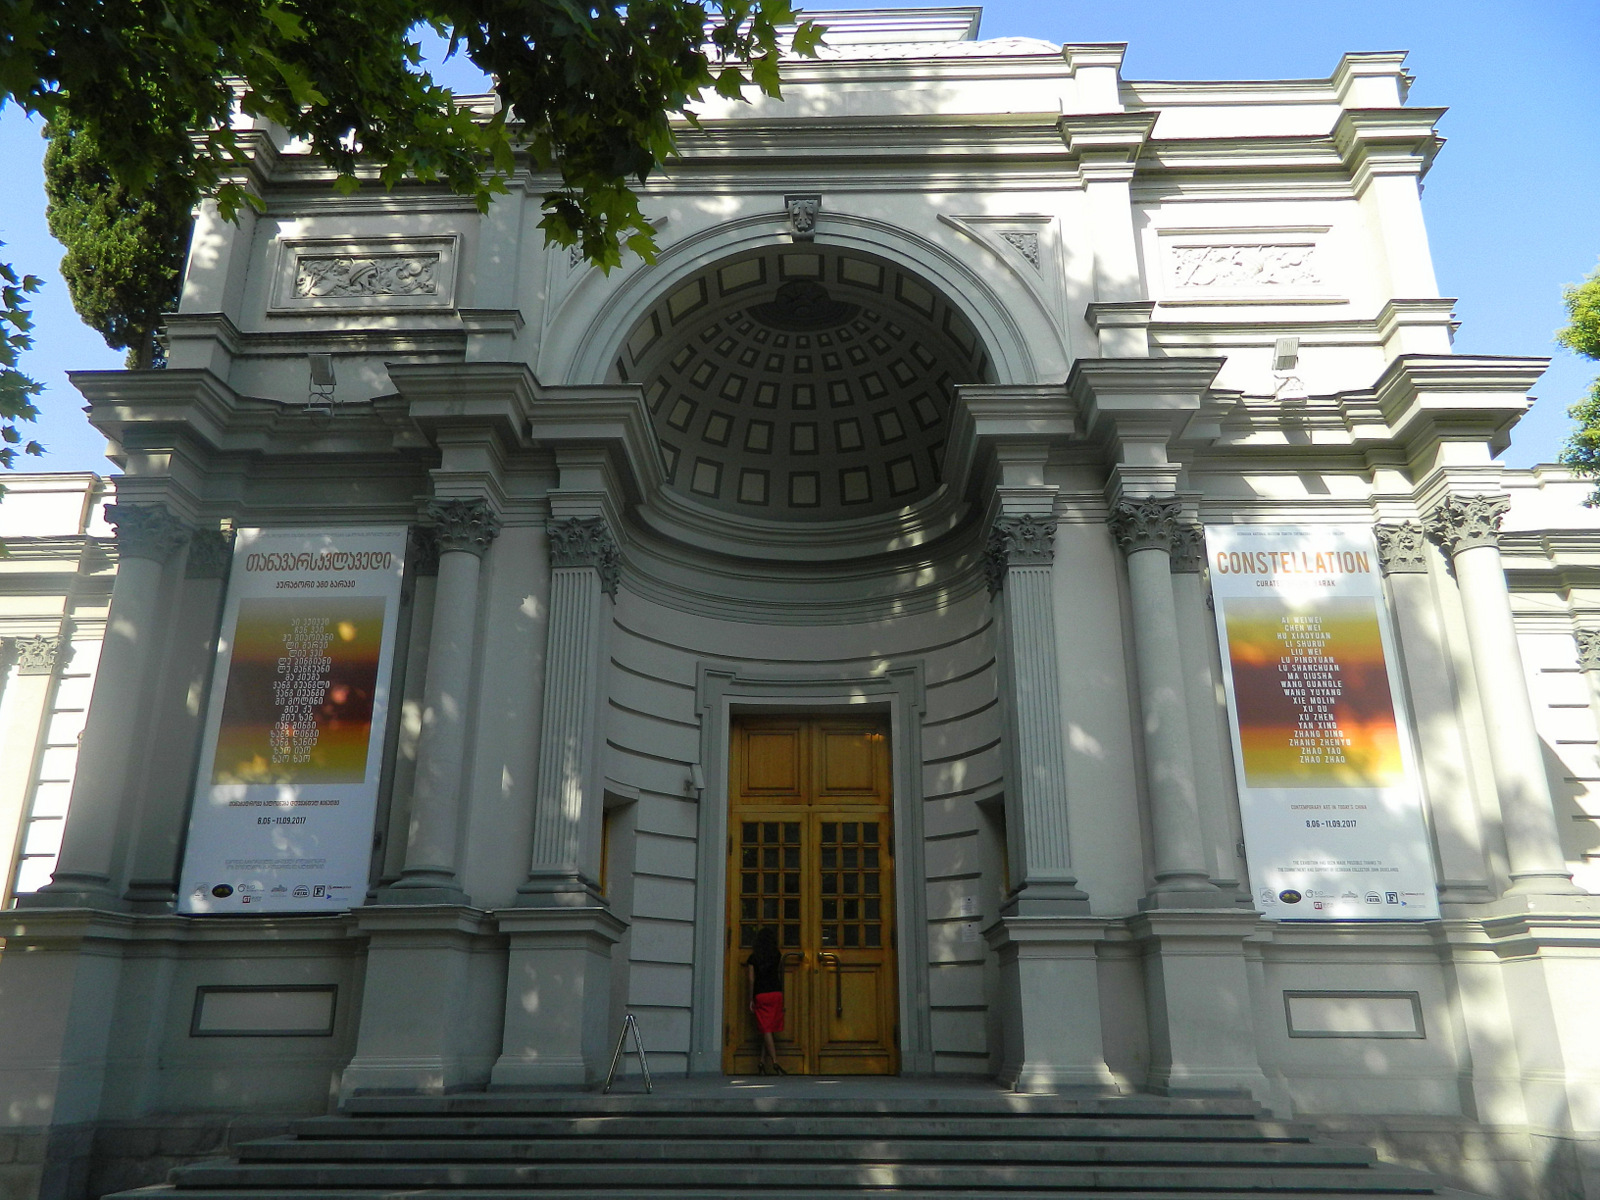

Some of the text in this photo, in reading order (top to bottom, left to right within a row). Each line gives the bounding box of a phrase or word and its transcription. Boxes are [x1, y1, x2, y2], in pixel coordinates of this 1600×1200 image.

[246, 552, 391, 571] თანავარსკვლავედი
[1217, 551, 1370, 574] CONSTELLATION
[1282, 616, 1322, 624] AI WEIWEI
[1285, 624, 1321, 632] CHEN WEI
[1277, 632, 1331, 640] HU XIAOYUAN
[1285, 640, 1326, 648] LI SHURUI
[1291, 648, 1322, 656] LIU WEI
[1281, 656, 1334, 664] LU PINGYUAN
[1278, 664, 1340, 672] LU SHANCHUAN
[1288, 672, 1332, 680] MA QIUSHA
[1280, 680, 1342, 688] WANG GUANGLE
[1284, 688, 1342, 696] WANG YUYANG
[1293, 696, 1335, 704] XIE MOLIN
[1294, 730, 1344, 738] ZHANG DING
[1289, 738, 1352, 746] ZHANG ZHENYU
[1300, 756, 1346, 764] ZHAO ZHAO
